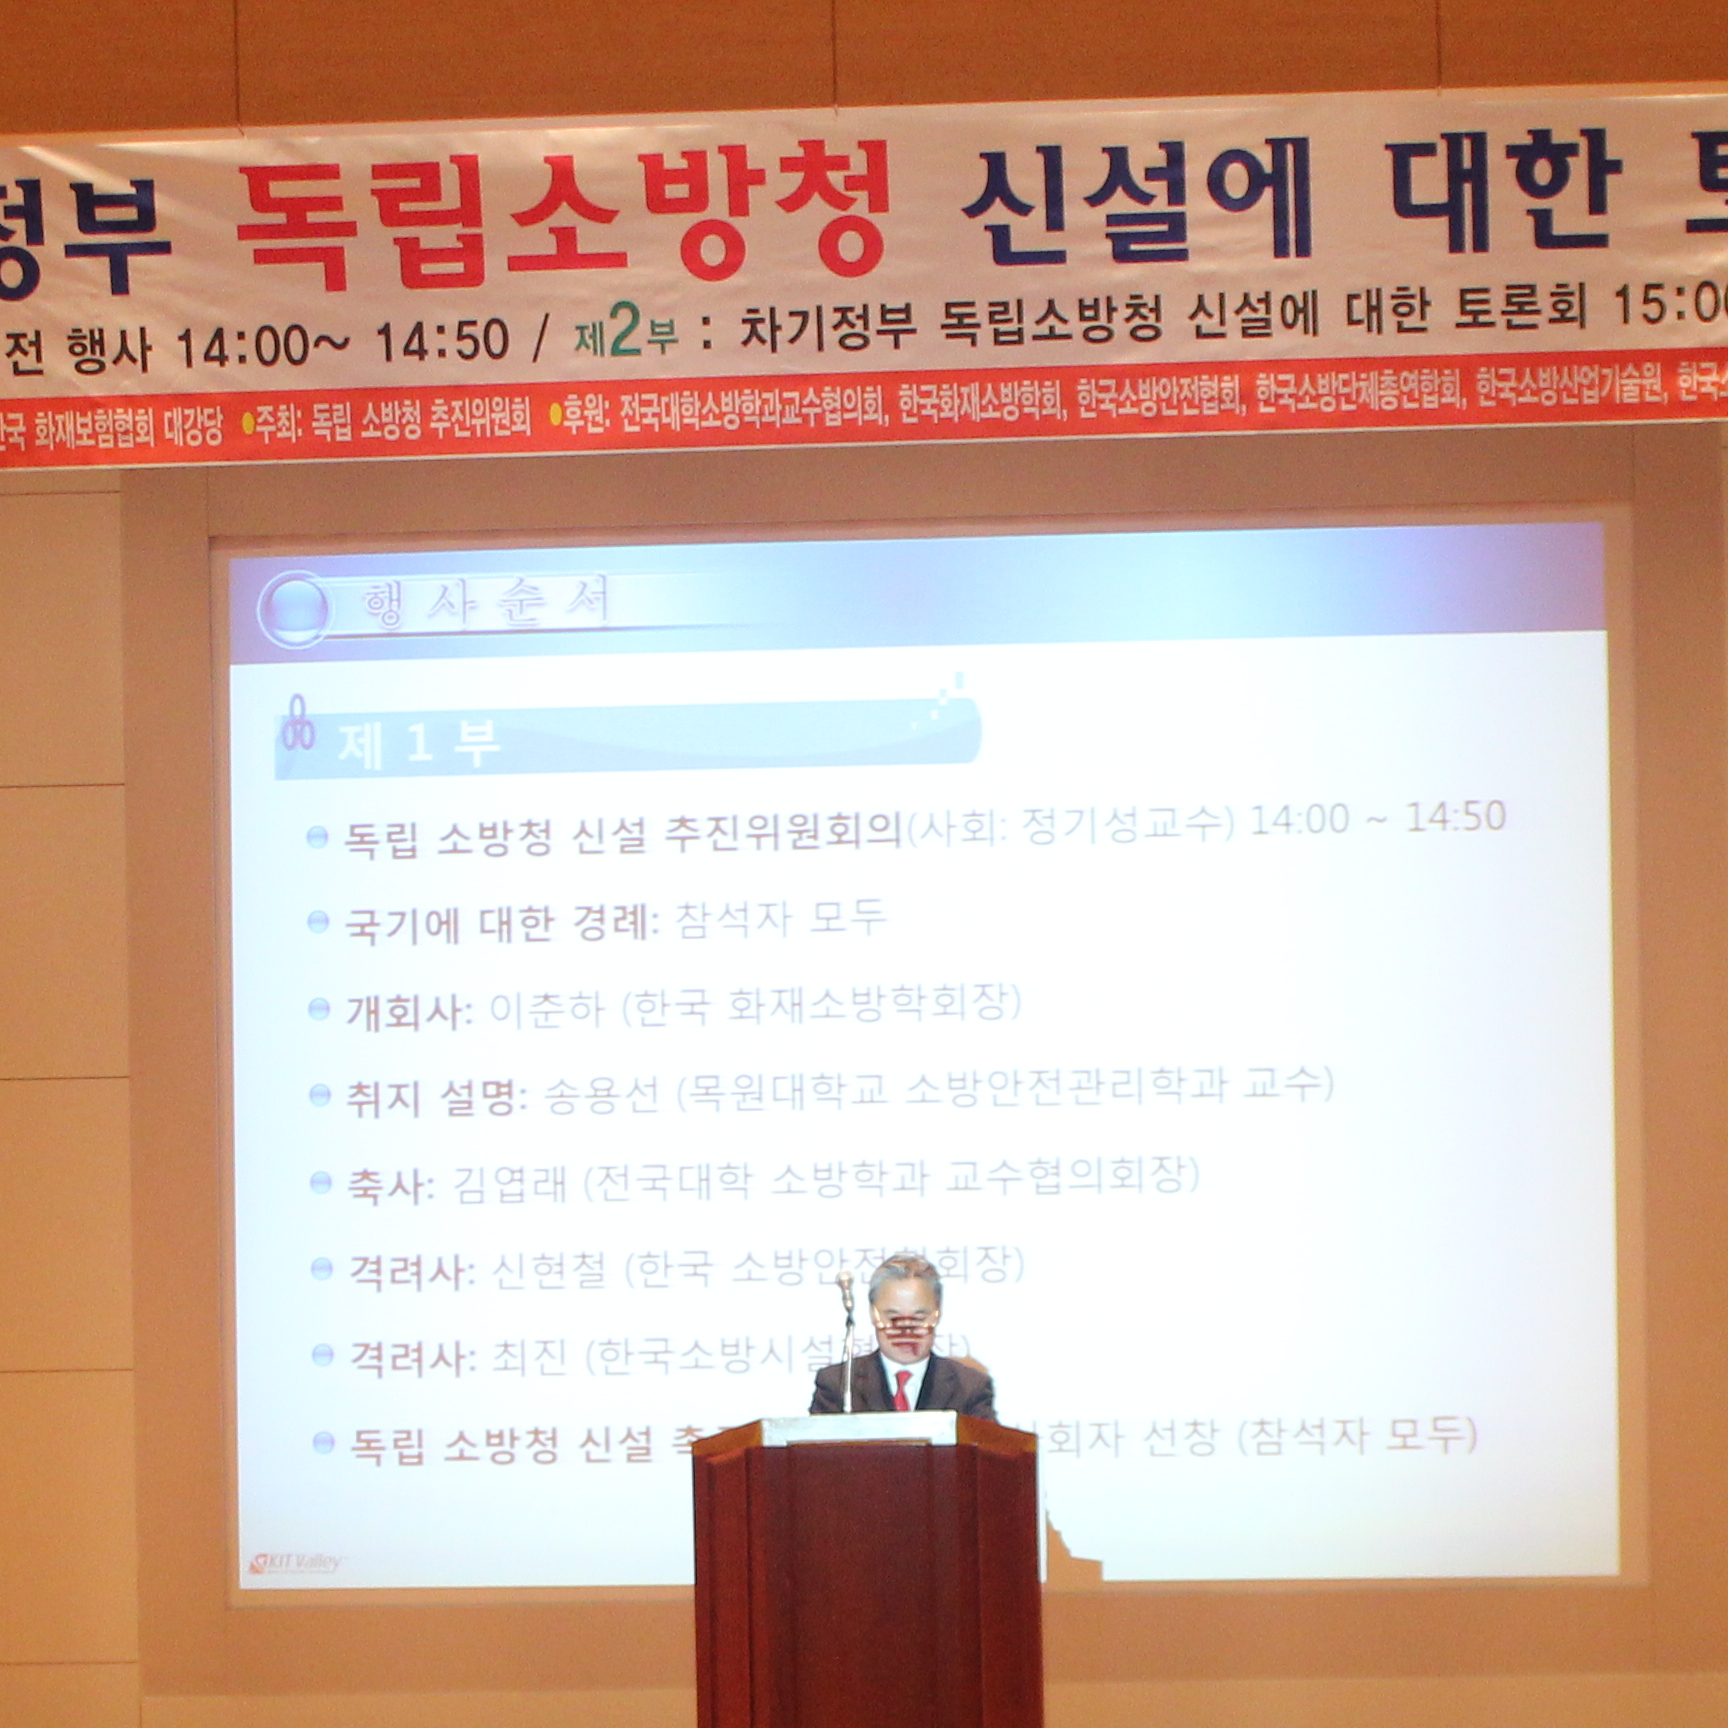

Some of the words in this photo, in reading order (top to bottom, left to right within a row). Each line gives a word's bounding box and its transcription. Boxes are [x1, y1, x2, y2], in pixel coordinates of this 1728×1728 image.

[237, 138, 890, 292] 독립소방청
[961, 137, 1311, 266] 신설에
[1385, 128, 1623, 253] 대한
[67, 327, 152, 375] 행사
[178, 324, 350, 368] 14:00~
[377, 318, 509, 362] 14:50
[575, 300, 678, 357] 제2부
[742, 303, 917, 353] 차기정부
[941, 294, 1161, 347] 독립소방청
[1189, 290, 1318, 339] 신설에
[1347, 286, 1431, 335] 대한
[1455, 282, 1585, 330] 토론회
[35, 408, 154, 448] 화재보험협회
[164, 407, 224, 446] 대강당
[254, 405, 303, 443] 주최:
[312, 403, 352, 441] 독립
[361, 400, 422, 440] 소방청
[429, 397, 531, 437] 추진위원회
[562, 394, 611, 434] 후원:
[345, 823, 417, 860] 독립
[438, 820, 550, 857] 소방청
[573, 817, 645, 854] 신설
[1252, 803, 1349, 835] 14:00
[1409, 799, 1507, 832] 14:50
[346, 908, 459, 946] 국기에
[480, 906, 555, 943] 대한
[575, 904, 658, 941] 경례:
[677, 901, 792, 939] 참석자
[811, 899, 886, 935] 모두
[347, 994, 471, 1032] 개회사:
[491, 991, 605, 1029] 이춘하
[623, 989, 711, 1027] (한국
[730, 983, 1020, 1024] 화재소방학회장)
[348, 1081, 419, 1118] 취지
[441, 1079, 526, 1117] 설명:
[545, 1076, 657, 1115] 송용선
[678, 1073, 887, 1112] (목원대학교
[907, 1067, 1228, 1108] 소방안전관리학과
[1245, 1066, 1334, 1102] 교수)
[349, 1169, 433, 1206] 축사:
[455, 1166, 565, 1204] 김엽래
[584, 1163, 753, 1202] (전국대학
[773, 1160, 930, 1199] 소방학과
[947, 1156, 1199, 1195] 교수협의회장)
[351, 1254, 474, 1292] 격려사:
[493, 1252, 604, 1290] 신현철
[626, 1250, 713, 1288] (한국
[731, 1245, 1024, 1288] 소방안전회장)
[352, 1341, 475, 1379] 격려사:
[494, 1339, 564, 1376] 최진
[351, 1429, 423, 1466] 독립
[445, 1427, 557, 1465] 소방청
[580, 1426, 652, 1463] 신설
[1014, 1420, 1126, 1459] 회자
[1145, 1419, 1220, 1457] 선창
[1239, 1417, 1370, 1456] (참석자
[1387, 1416, 1478, 1454] 모두)
